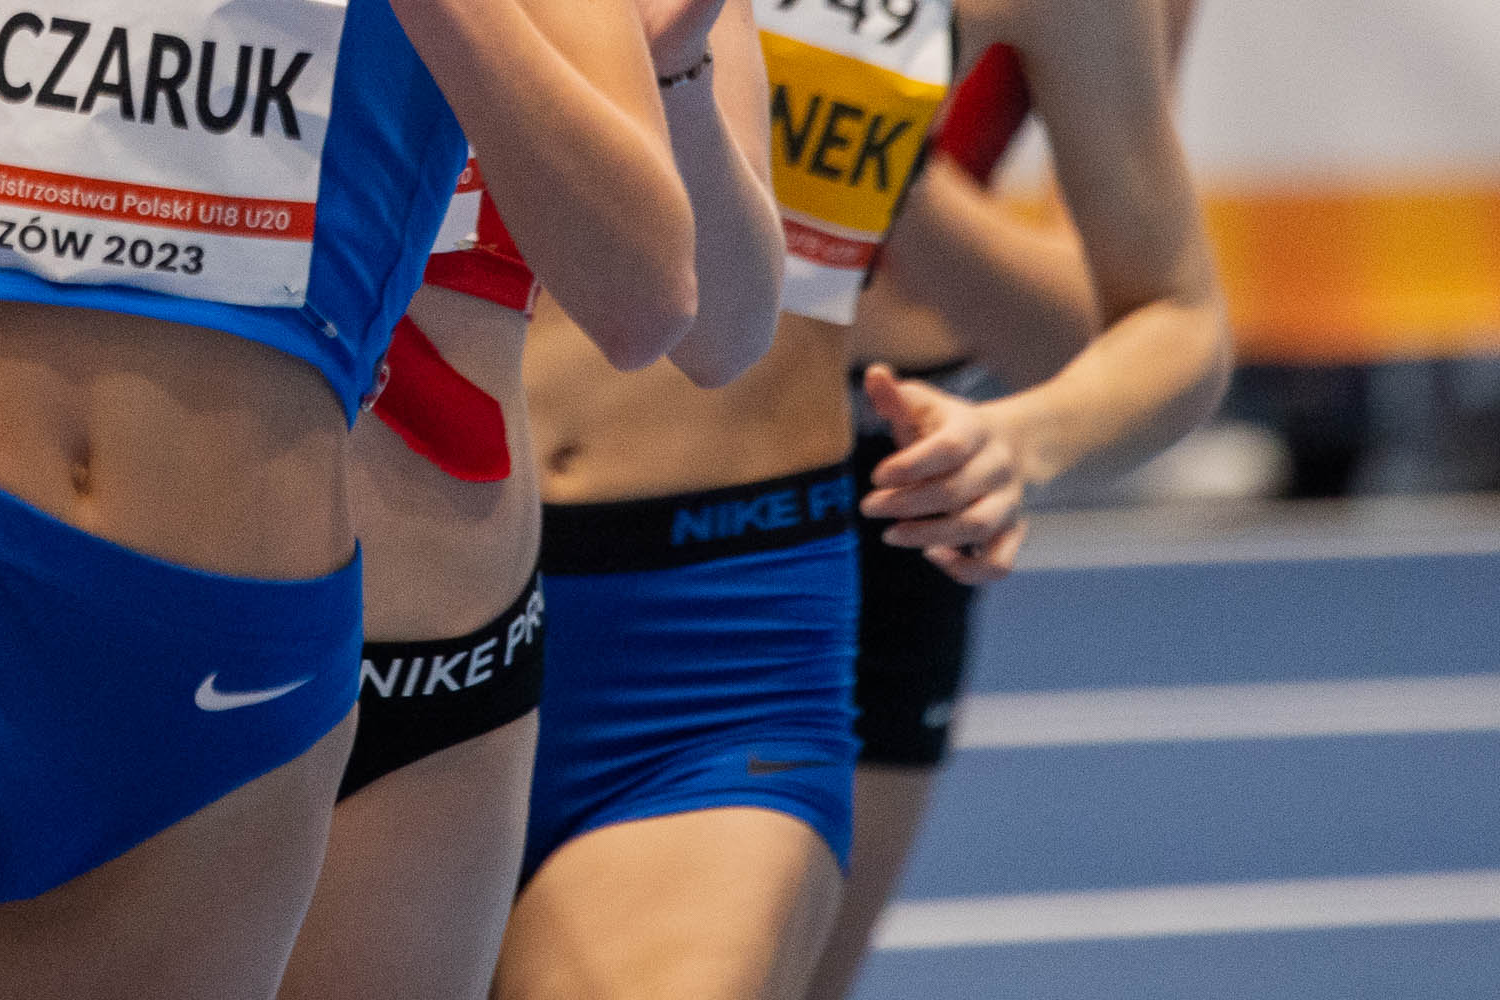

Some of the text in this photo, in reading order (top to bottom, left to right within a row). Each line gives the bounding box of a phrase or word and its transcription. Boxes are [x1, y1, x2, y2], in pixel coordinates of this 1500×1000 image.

[122, 194, 193, 222] Polski
[198, 204, 239, 227] U18
[245, 209, 291, 231] U20
[102, 234, 205, 275] 2023
[670, 489, 800, 547] NIKE
[359, 570, 546, 697] NIKE PR
